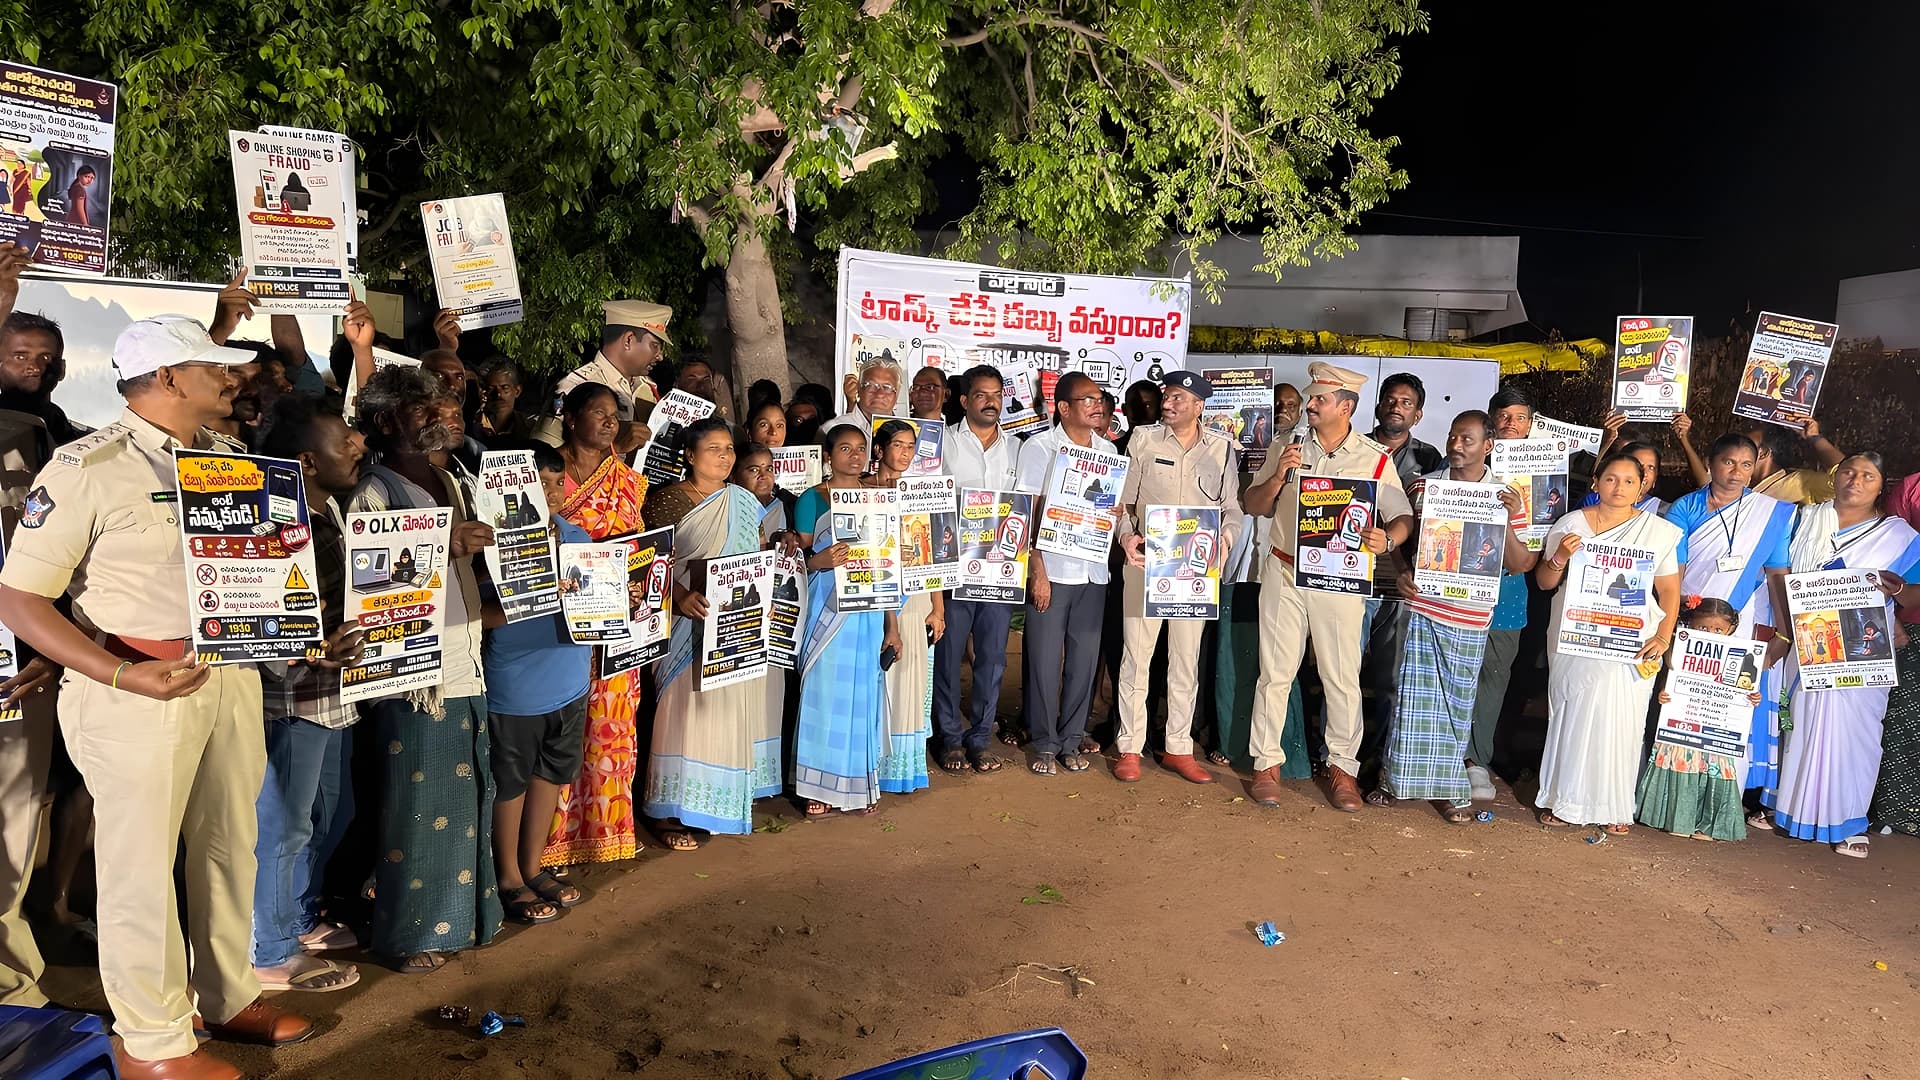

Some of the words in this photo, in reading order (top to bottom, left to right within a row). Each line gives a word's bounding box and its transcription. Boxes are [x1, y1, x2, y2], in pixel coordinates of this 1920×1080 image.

[254, 143, 284, 154] ONLINE
[286, 147, 322, 159] SHOPING
[269, 155, 310, 170] FRAUD
[43, 249, 59, 257] 112
[249, 283, 272, 295] NTR
[274, 283, 299, 291] POLICE
[861, 291, 939, 332] టాస్క్
[949, 292, 996, 337] చేస్తే
[1003, 302, 1062, 342] డబ్బు
[1069, 306, 1181, 343] వస్తుందా?
[1546, 424, 1588, 439] INVESTMENT
[1069, 448, 1097, 460] CREDIT
[1097, 455, 1118, 466] CARD
[773, 459, 806, 474] RAUD
[1075, 460, 1108, 475] FRAUD
[842, 492, 860, 503] OLX
[189, 504, 260, 531] నమ్మకండి!
[369, 517, 401, 534] OLX
[402, 515, 435, 531] మోసం
[283, 526, 309, 544] SCAM
[1586, 544, 1618, 555] CREDIT
[1620, 547, 1644, 558] CARD
[1596, 554, 1633, 569] FRAUD
[229, 624, 251, 632] 1930
[1686, 639, 1723, 659] LOAN
[344, 667, 366, 683] NTR
[367, 662, 392, 673] POLICE
[1682, 655, 1720, 675] FRAUD
